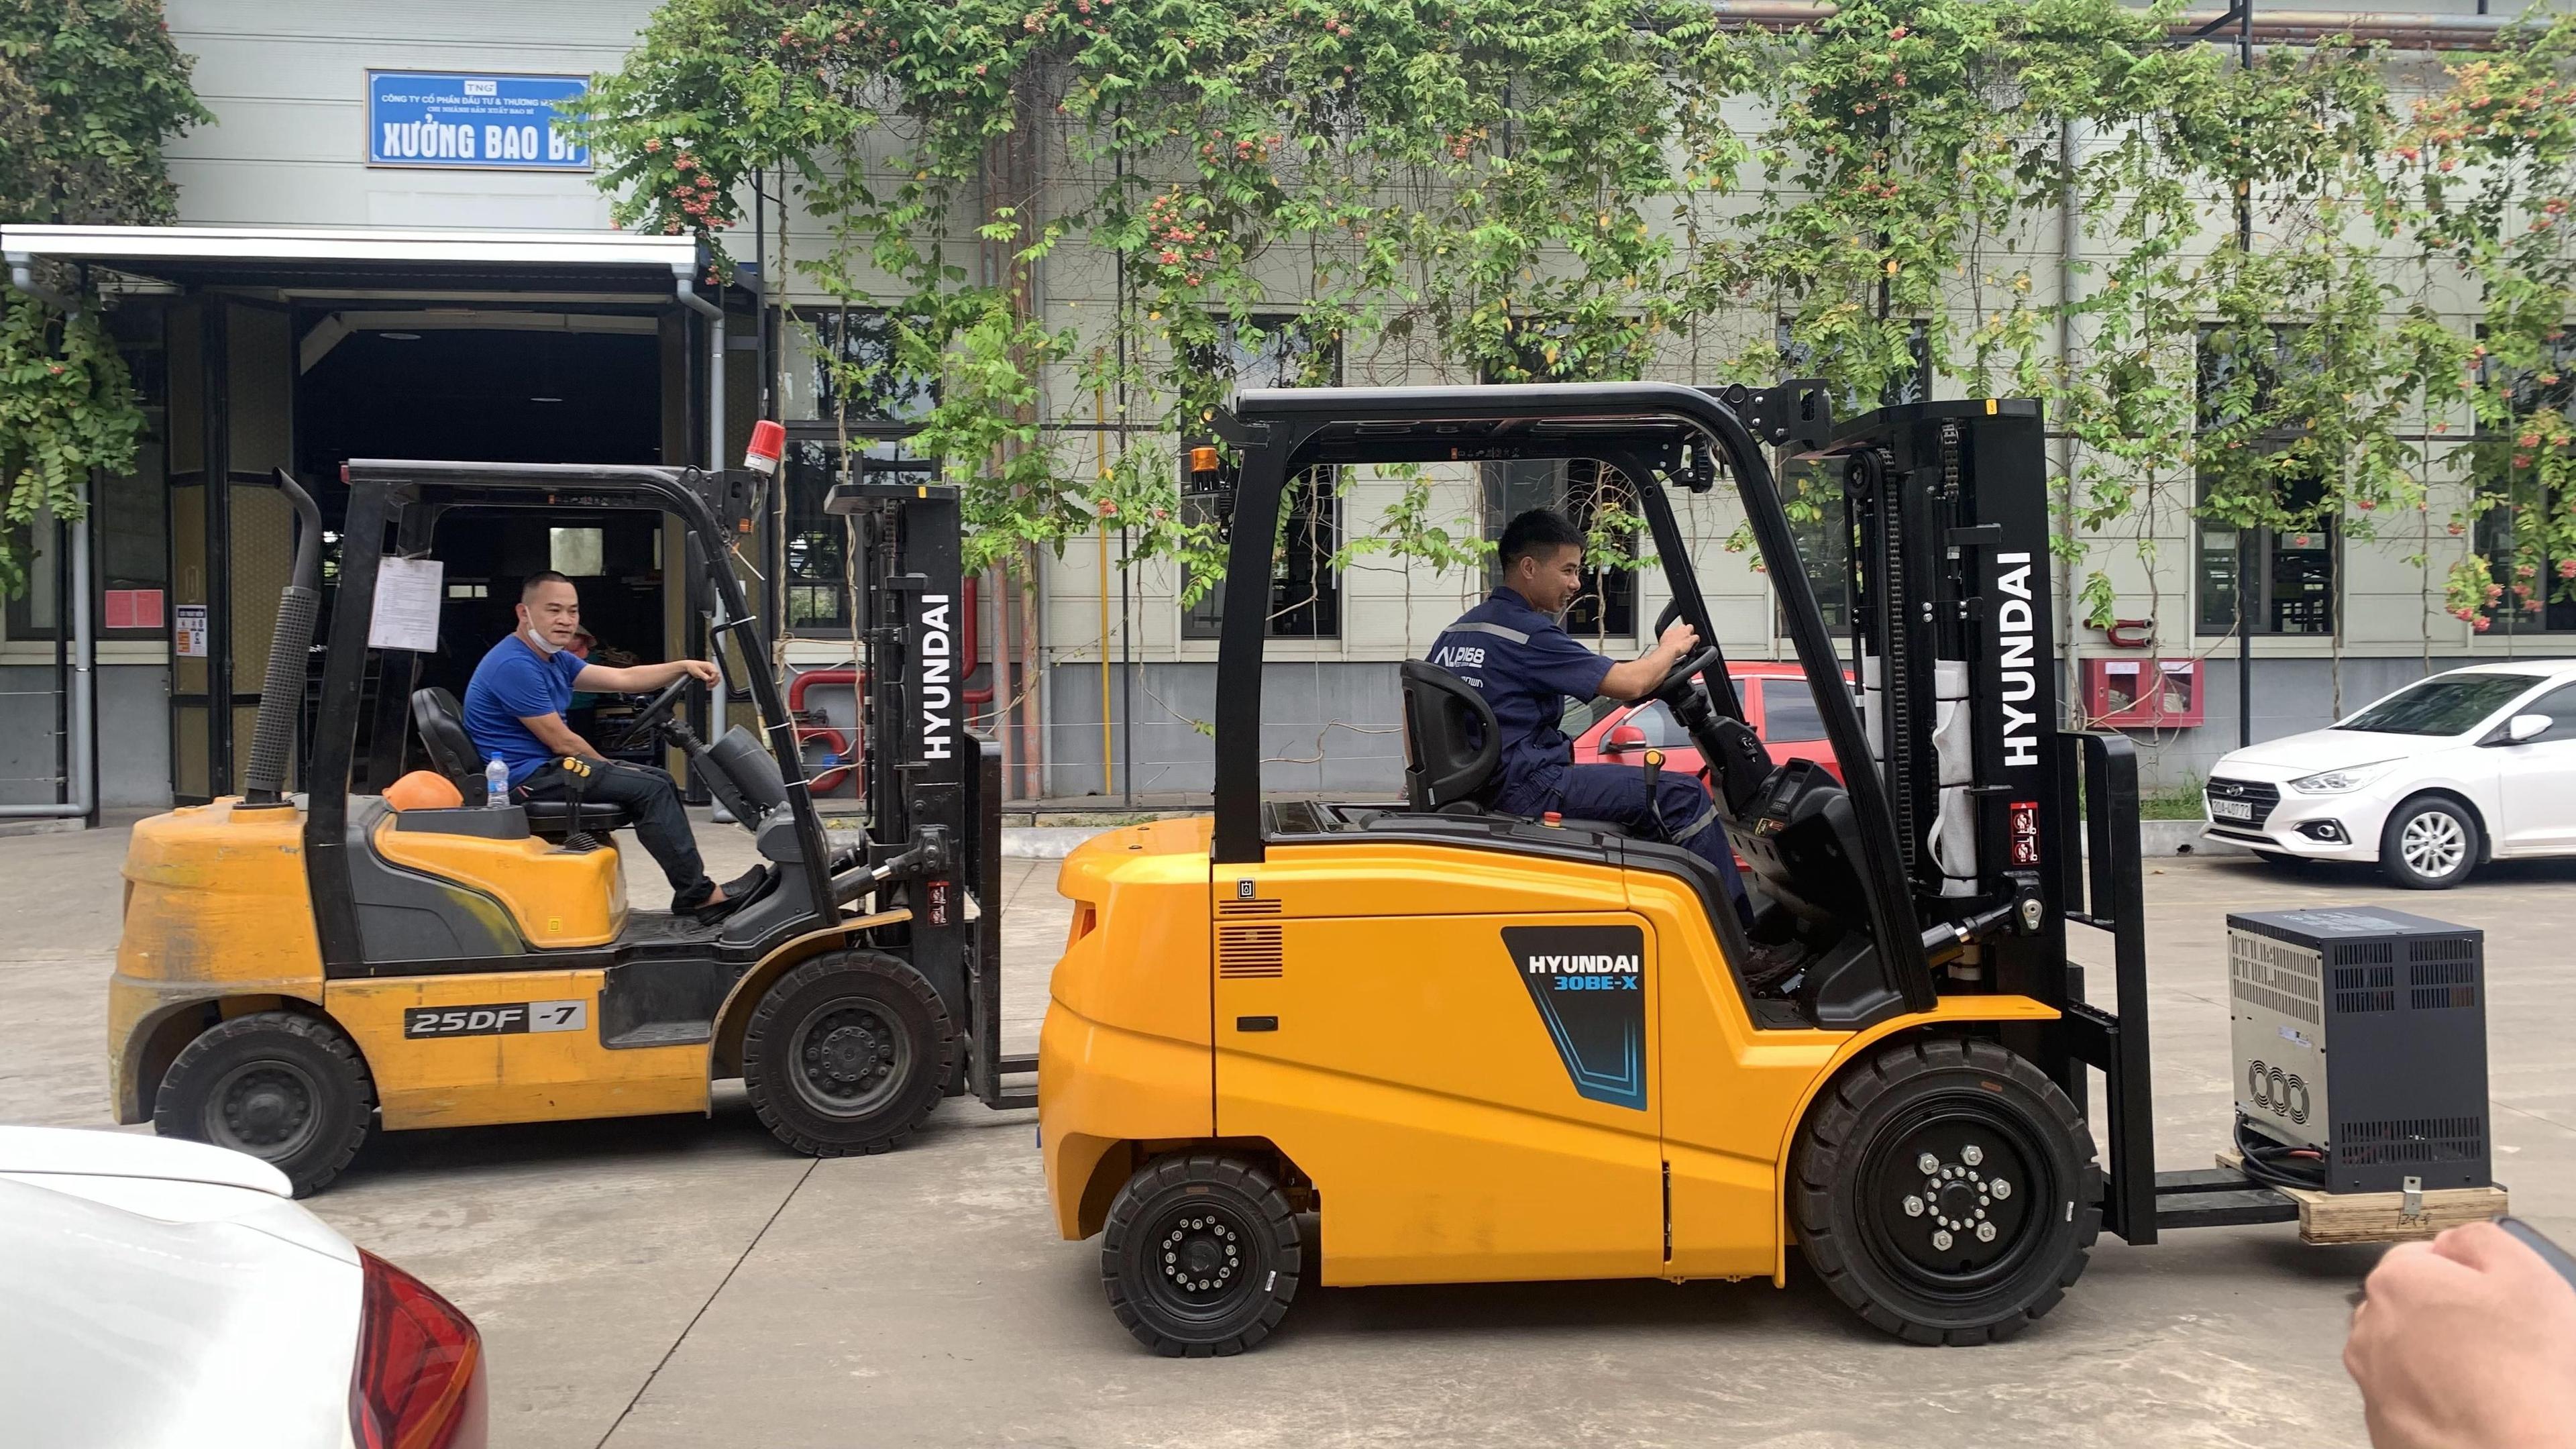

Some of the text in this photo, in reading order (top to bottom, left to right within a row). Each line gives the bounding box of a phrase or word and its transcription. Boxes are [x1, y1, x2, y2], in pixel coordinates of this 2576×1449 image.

[381, 93, 408, 103] CÔNG
[467, 84, 494, 92] TNG
[383, 113, 475, 158] XƯỞNG
[485, 125, 538, 160] BAO
[1996, 551, 2038, 766] HYUNDAI
[922, 594, 951, 759] HYUNDAI
[1529, 955, 1639, 973] HYUNDAI
[1554, 975, 1638, 991] 30BE-X
[411, 1006, 578, 1033] 25DF -7
